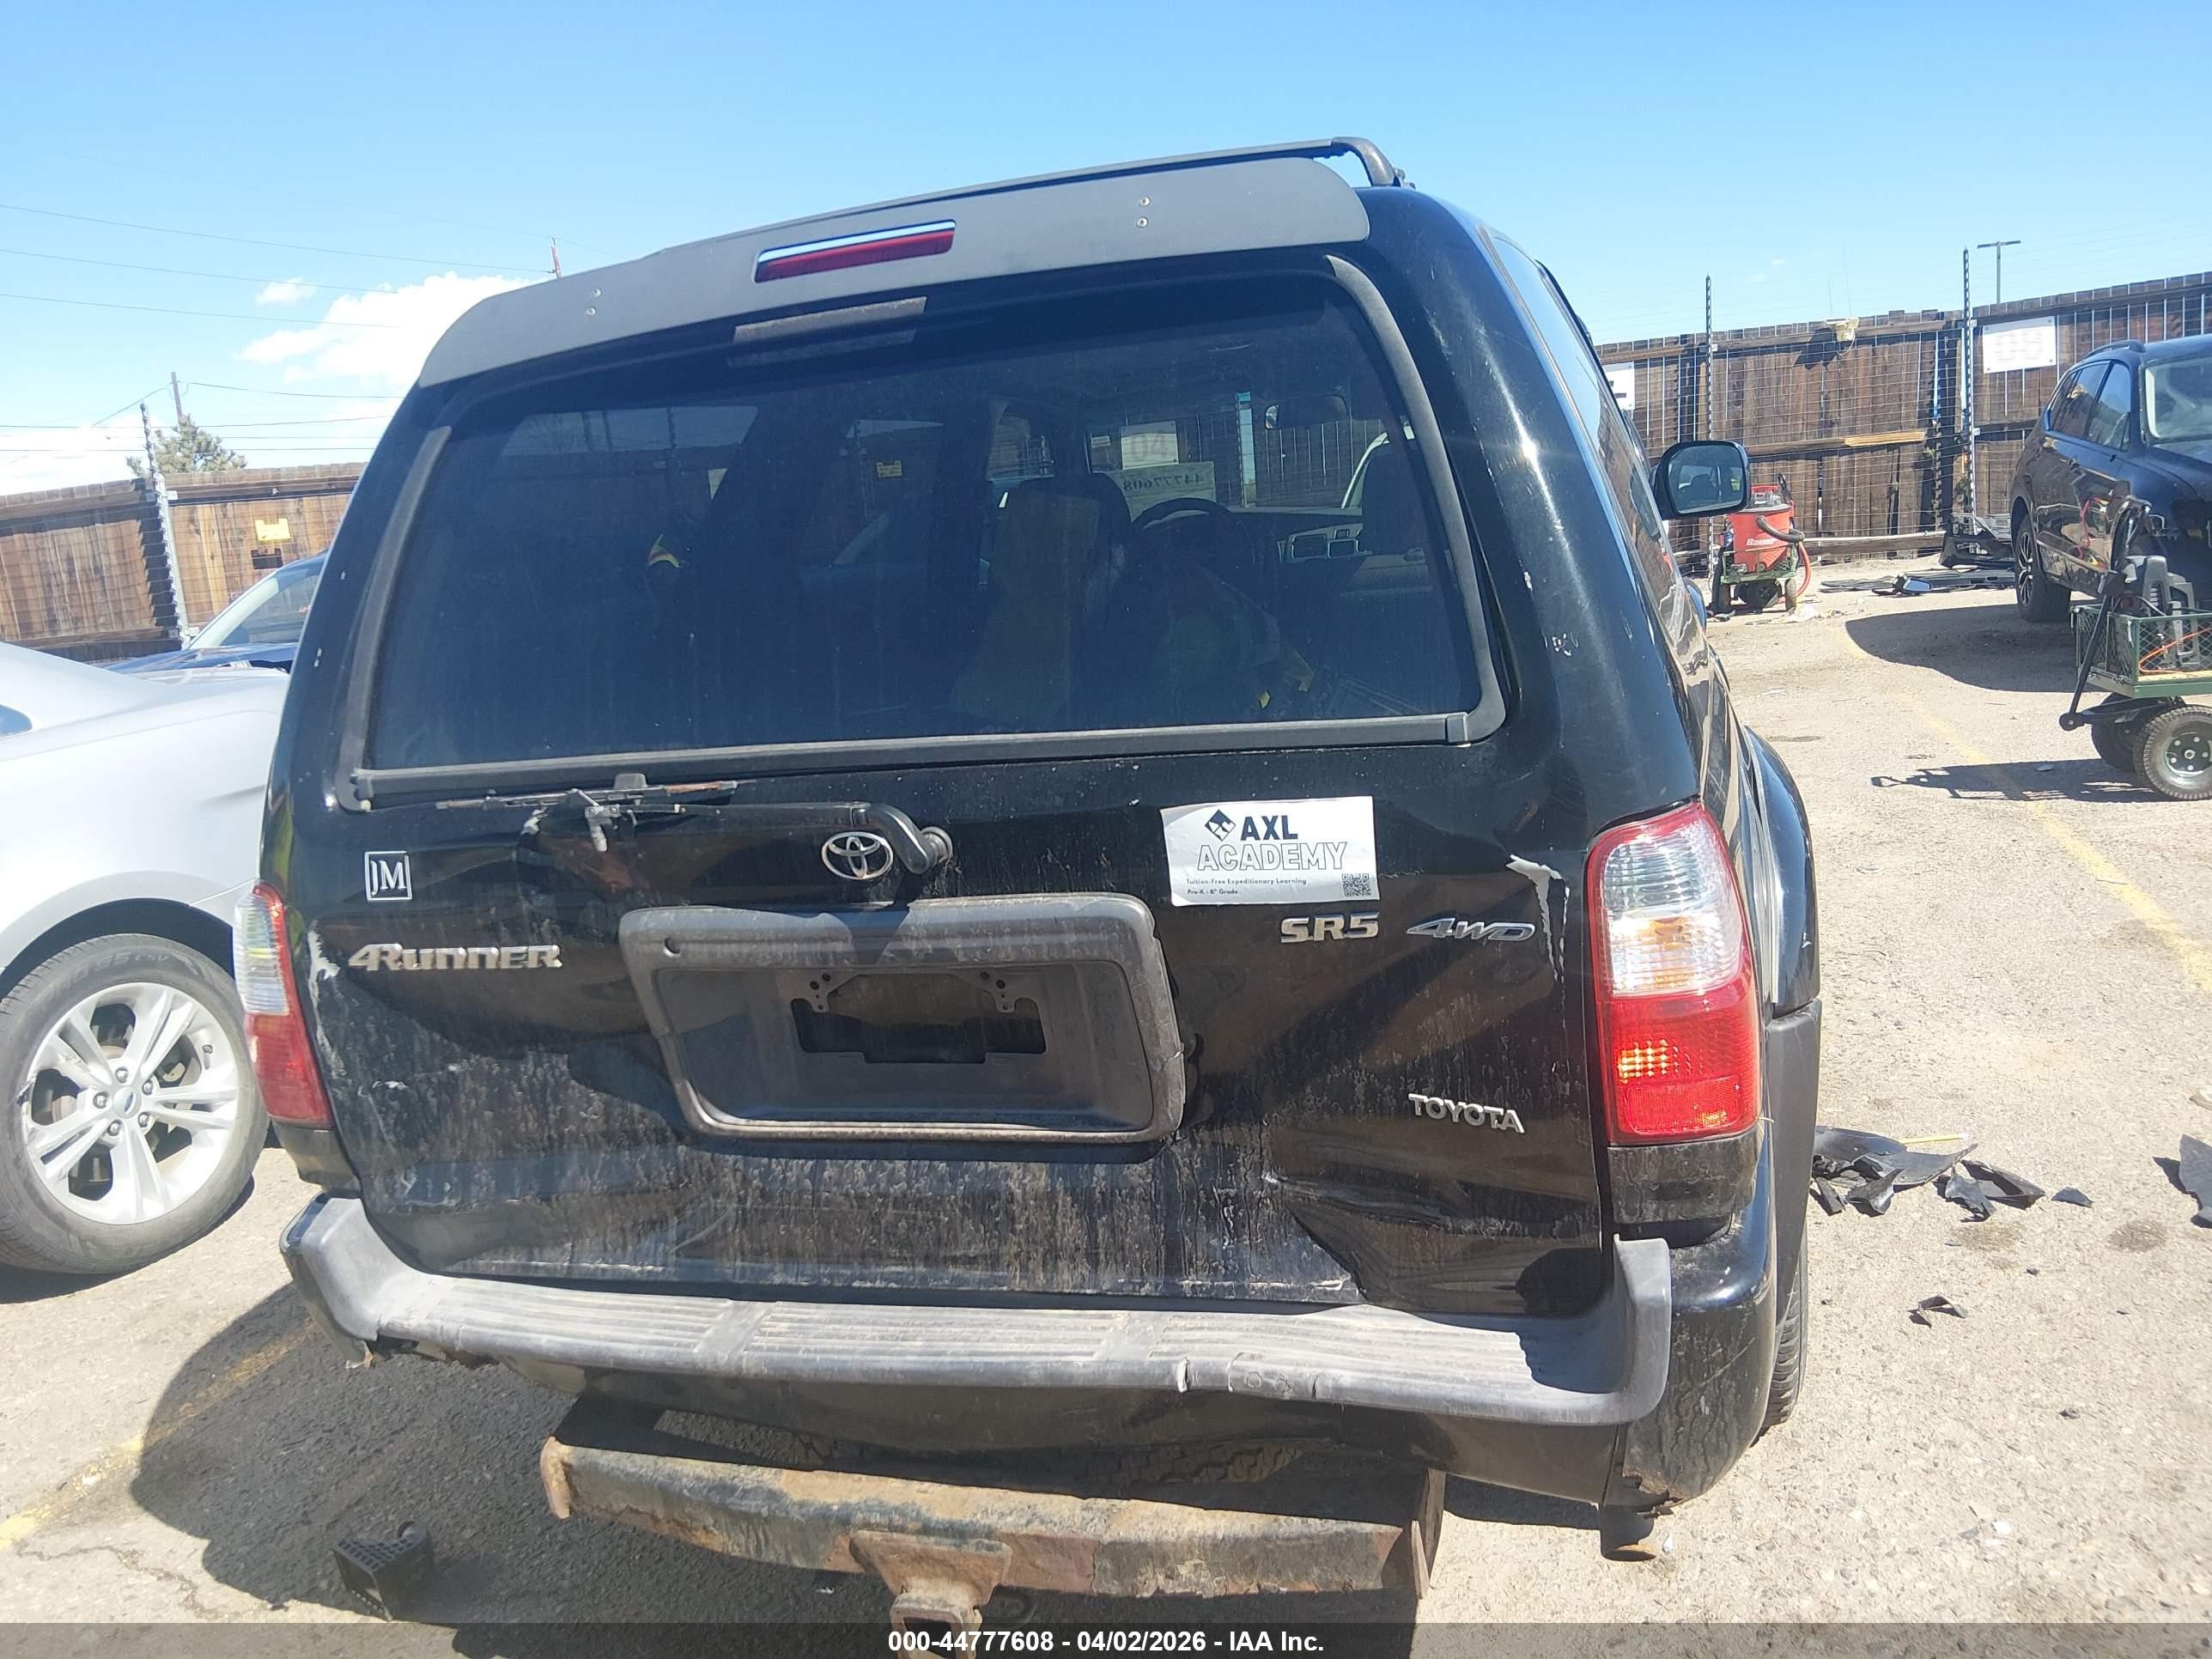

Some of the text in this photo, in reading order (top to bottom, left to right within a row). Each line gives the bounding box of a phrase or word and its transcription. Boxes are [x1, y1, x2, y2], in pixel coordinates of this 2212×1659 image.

[1240, 814, 1298, 841] AXL
[1197, 841, 1348, 872] ACADEMY
[1276, 878, 1307, 886] Learning
[1280, 912, 1380, 943] SR5
[1406, 917, 1536, 941] 4WD
[1408, 1093, 1525, 1133] TOYOTA
